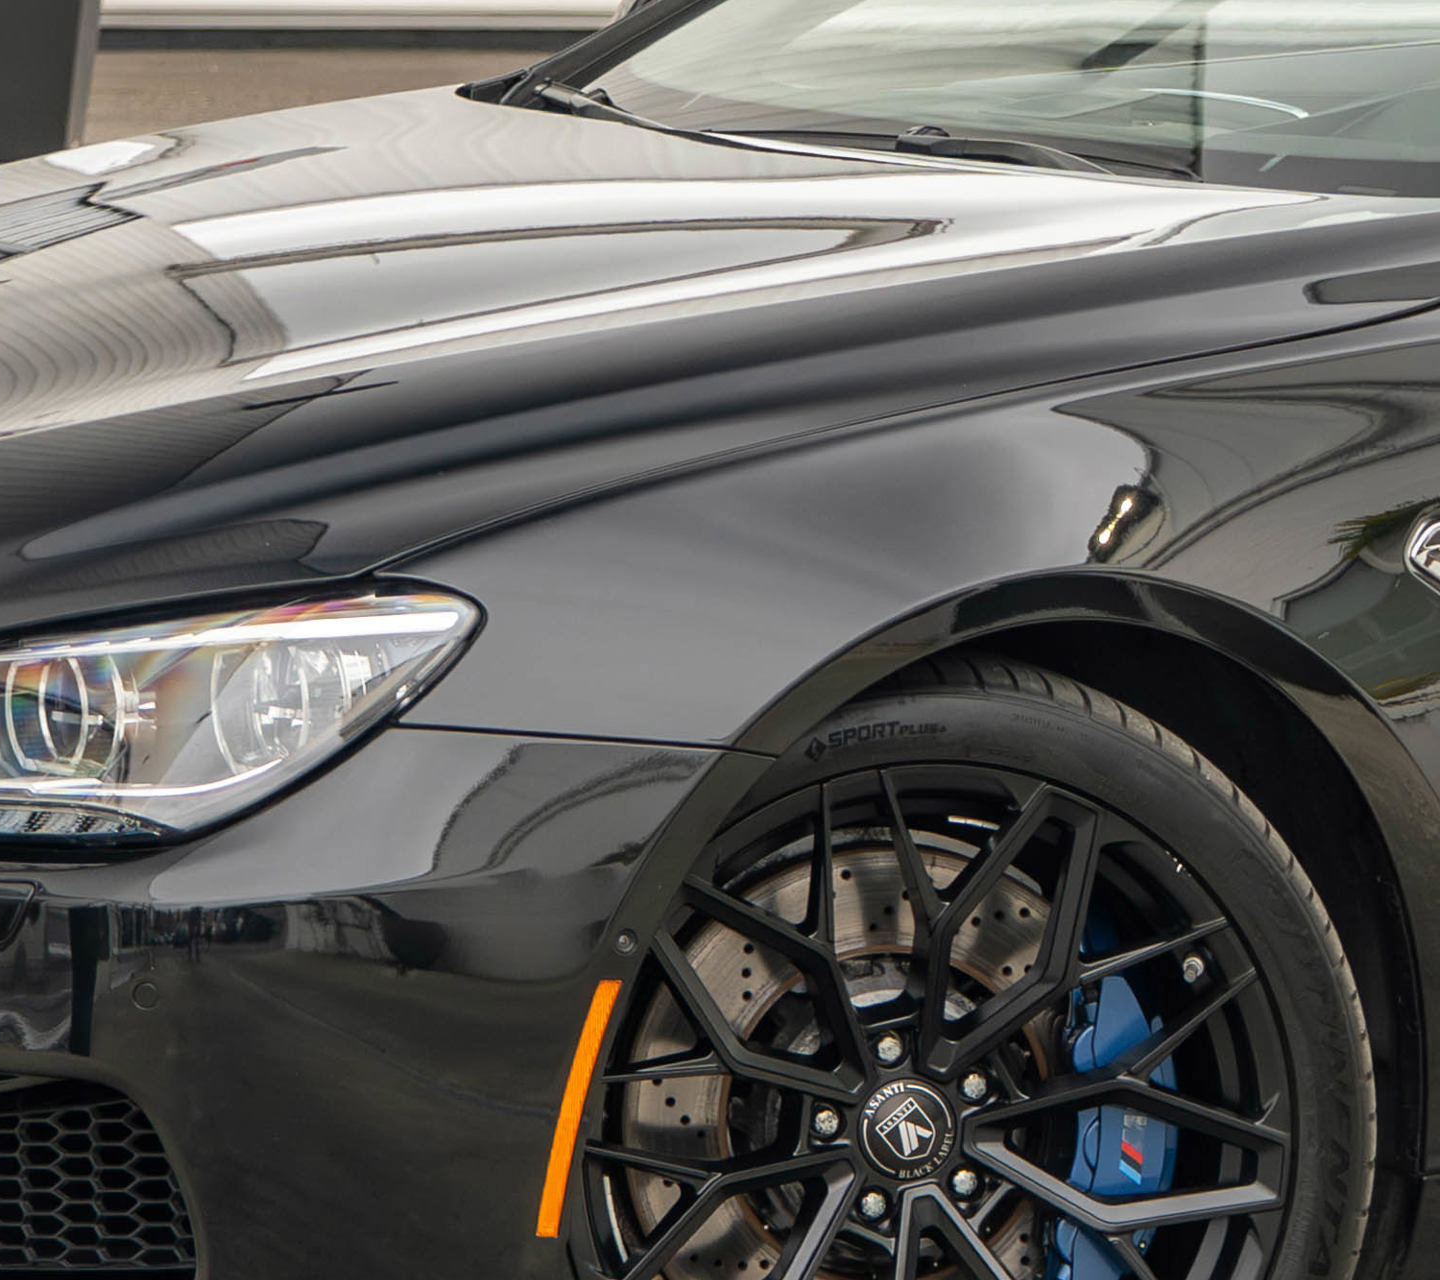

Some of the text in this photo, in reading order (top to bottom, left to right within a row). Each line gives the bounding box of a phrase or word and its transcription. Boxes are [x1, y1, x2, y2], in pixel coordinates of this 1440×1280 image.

[827, 720, 900, 750] SPORT
[864, 1082, 905, 1118] ASANTI
[898, 1132, 953, 1179] BLACK LABEL
